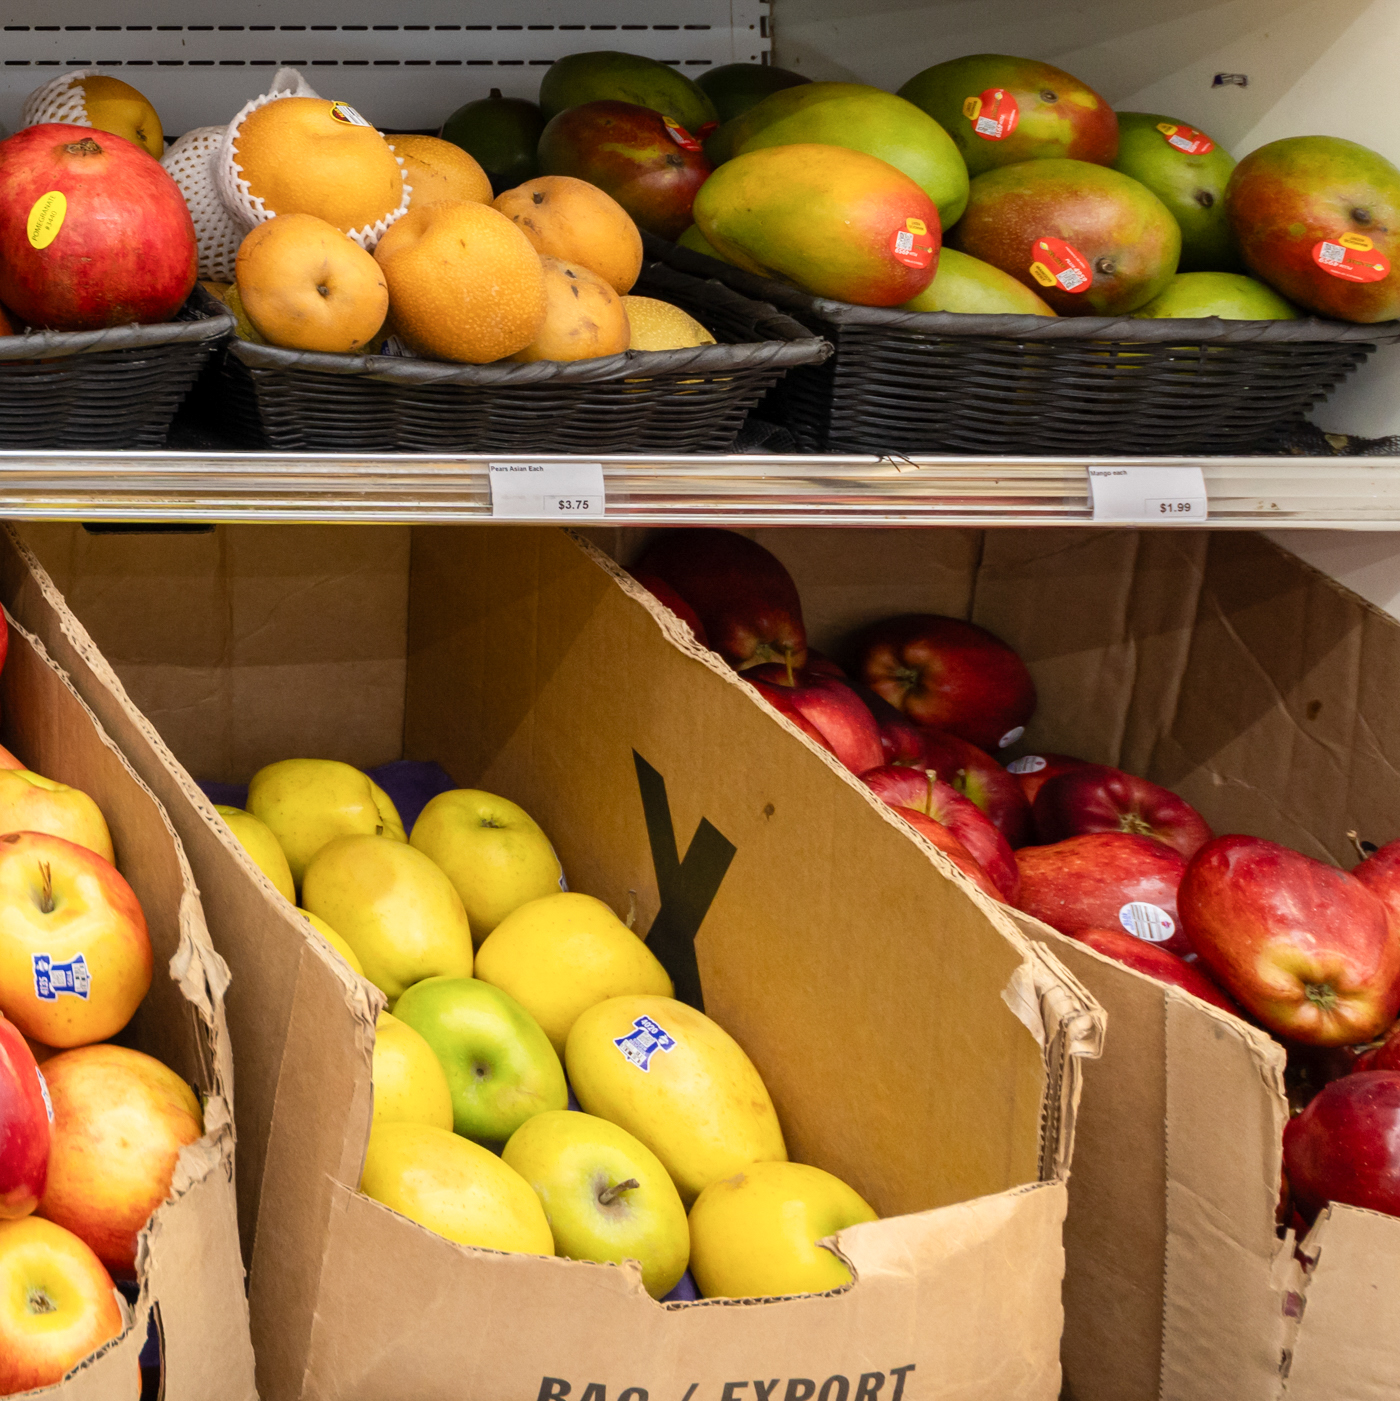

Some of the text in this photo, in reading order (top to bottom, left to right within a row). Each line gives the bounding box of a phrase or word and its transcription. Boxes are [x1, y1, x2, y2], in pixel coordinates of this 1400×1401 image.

[32, 194, 57, 242] POMEGRANATE
[558, 500, 589, 510] $3.75
[1160, 503, 1191, 514] $1.99
[641, 1019, 658, 1034] 4020
